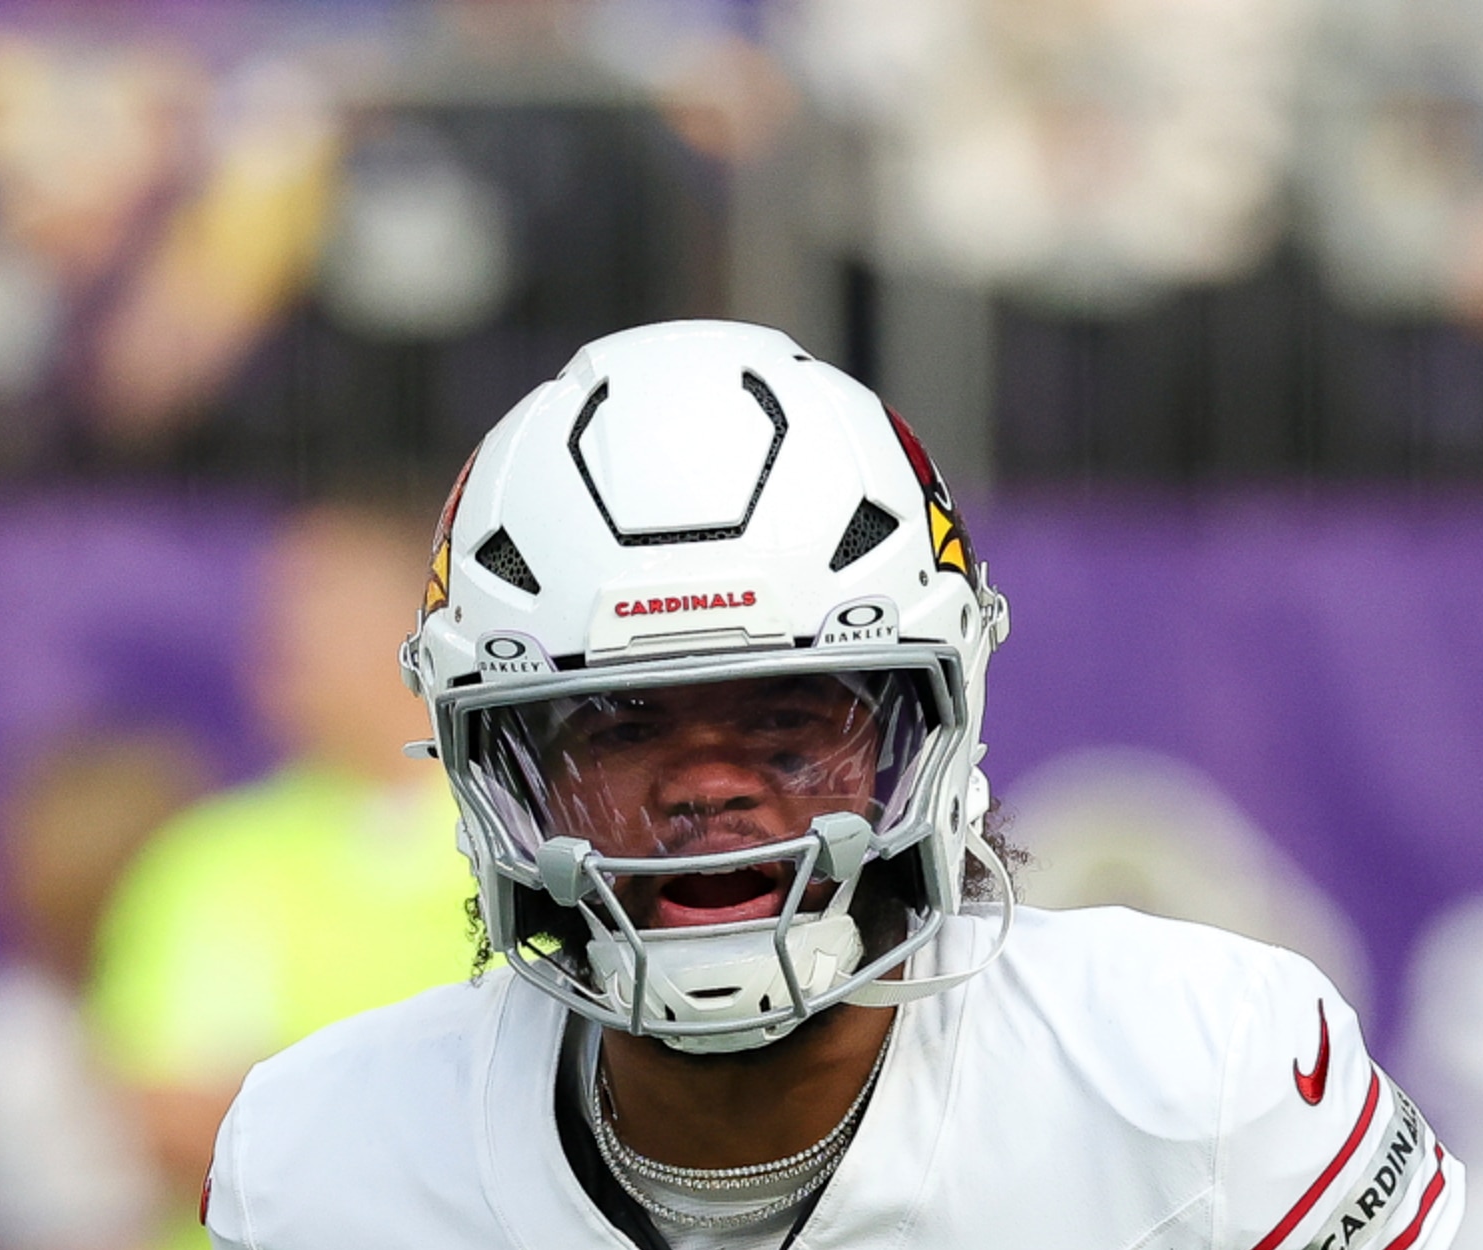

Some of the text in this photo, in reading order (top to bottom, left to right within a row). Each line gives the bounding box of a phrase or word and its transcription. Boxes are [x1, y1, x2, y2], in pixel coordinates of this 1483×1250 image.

[615, 591, 756, 617] CARDINALS
[824, 626, 894, 644] OAKLEY
[479, 661, 539, 673] OAKLEY
